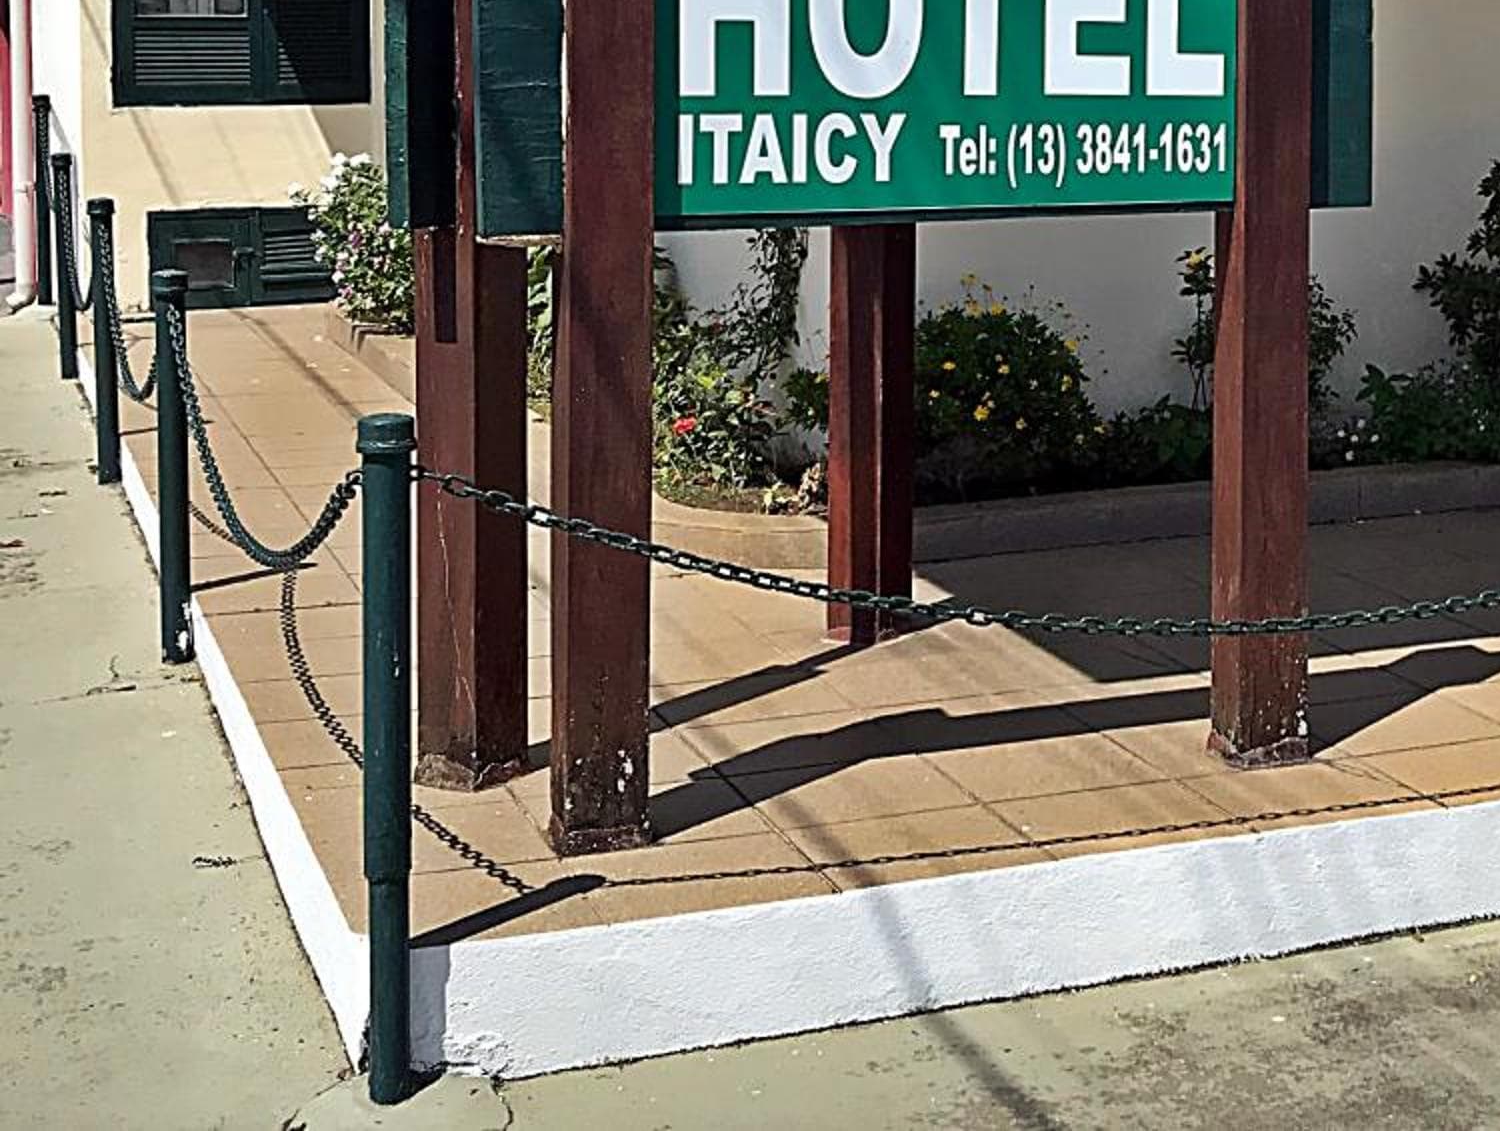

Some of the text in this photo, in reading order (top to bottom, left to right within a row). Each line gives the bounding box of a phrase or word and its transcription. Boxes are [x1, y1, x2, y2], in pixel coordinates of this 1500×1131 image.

[678, 113, 1227, 187] ITAICY Tel: (13) 3841-1631
